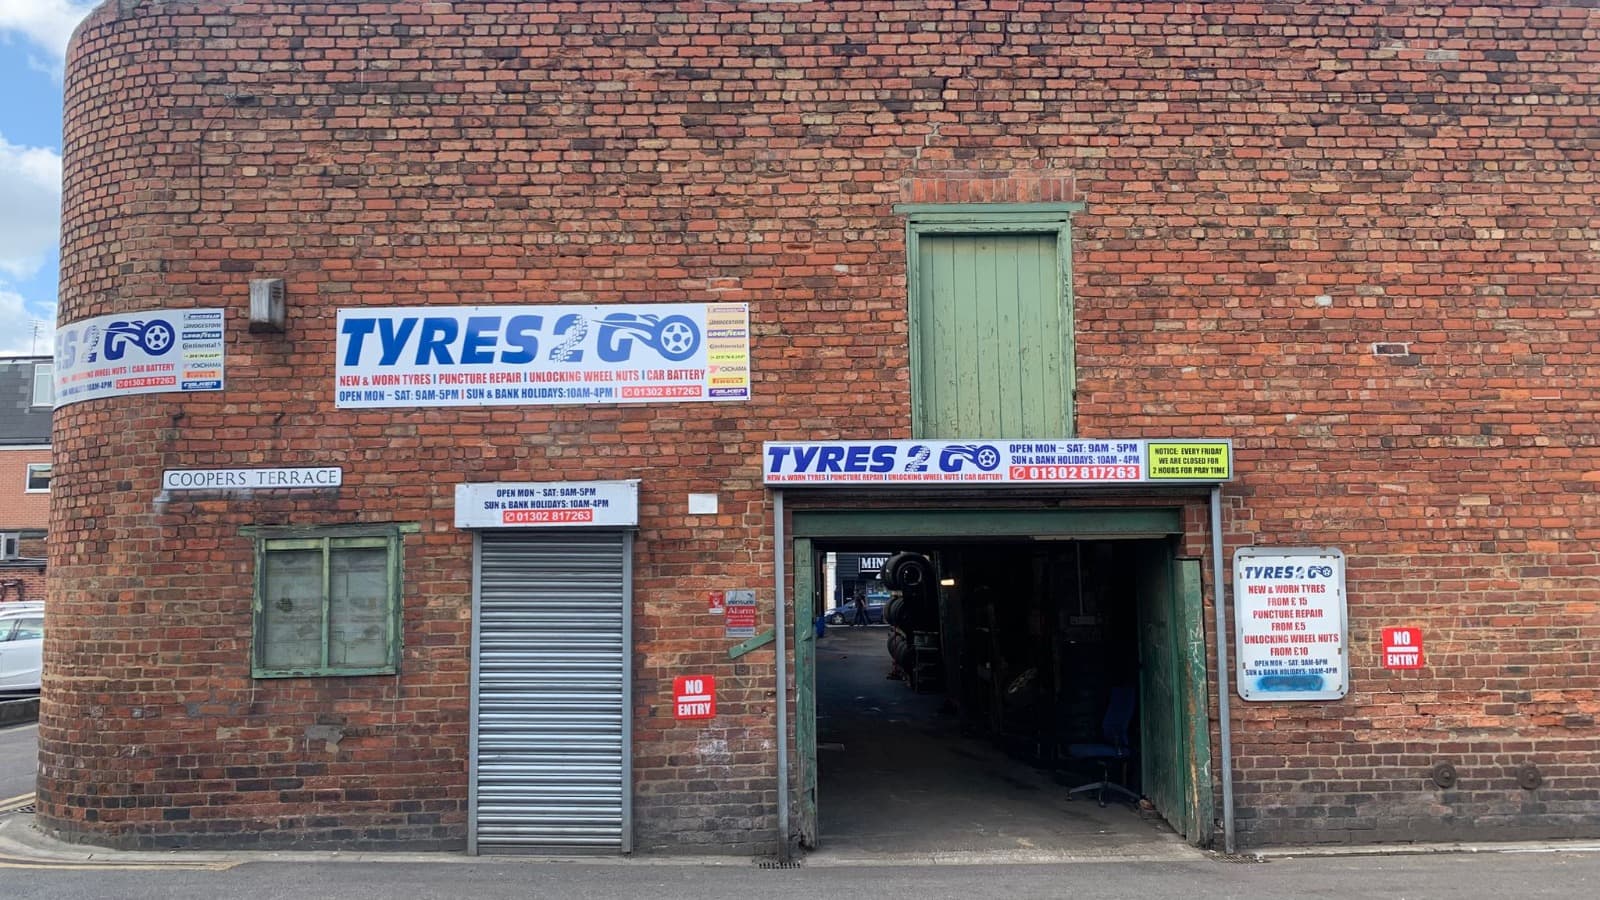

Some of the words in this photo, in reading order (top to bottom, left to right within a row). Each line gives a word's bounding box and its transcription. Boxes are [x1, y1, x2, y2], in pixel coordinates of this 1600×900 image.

[342, 315, 543, 366] TYRES
[549, 314, 588, 363] 2
[132, 364, 145, 373] CAR
[146, 364, 174, 372] BATTERY
[340, 376, 360, 386] NEW
[362, 376, 369, 386] &
[372, 375, 400, 386] WORN
[403, 374, 430, 385] TYRES
[438, 373, 487, 384] PUNCTURE
[490, 372, 522, 384] REPAIR
[530, 370, 581, 382] UNLOCKING
[584, 370, 613, 382] WHEEL
[616, 370, 639, 381] NUTS
[647, 370, 664, 380] CAR
[668, 369, 705, 380] BATTERY
[340, 390, 362, 401] OPEN
[364, 390, 384, 400] MON
[394, 390, 413, 400] SAT:
[416, 389, 459, 400] 9AM-5PM
[466, 388, 484, 399] SUN
[487, 390, 492, 398] &
[495, 388, 519, 398] BANK
[634, 386, 662, 396] 01302
[666, 386, 700, 396] 817263
[1010, 444, 1032, 453] OPEN
[1035, 444, 1056, 452] MON
[1066, 444, 1086, 452] SAT:
[1088, 444, 1108, 452] 9AM
[1116, 444, 1137, 452] 5PM
[768, 446, 897, 472] TYRES
[904, 445, 930, 472] 2
[1012, 456, 1026, 464] SUN
[1036, 456, 1056, 464] BANK
[1058, 456, 1096, 464] HOLIDAYS:
[1097, 455, 1117, 464] 10AM
[1123, 456, 1140, 464] 4PM
[168, 472, 246, 486] COOPERS
[256, 470, 337, 485] TERRACE
[1030, 467, 1077, 480] 01302
[1080, 467, 1136, 479] 817263
[496, 489, 516, 497] OPEN
[518, 488, 534, 497] MON
[542, 488, 558, 497] SAT:
[560, 488, 596, 496] 9AM-5PM
[484, 501, 499, 509] SUN
[508, 500, 529, 509] BANK
[530, 500, 568, 508] HOLIDAYS:
[570, 499, 609, 508] 10AM-4PM
[516, 512, 549, 521] 01302
[552, 511, 590, 520] 817263
[862, 557, 888, 568] MIN
[1245, 566, 1294, 579] TYRES
[1296, 566, 1304, 579] 2
[1248, 585, 1266, 594] NEW
[1268, 586, 1273, 594] &
[1275, 585, 1299, 594] WORN
[1302, 584, 1326, 593] TYRES
[1268, 598, 1290, 606] FROM
[1299, 597, 1307, 606] 15
[1253, 610, 1294, 619] PUNCTURE
[1295, 609, 1323, 618] REPAIR
[1272, 622, 1293, 631] FROM
[1295, 622, 1306, 630] £5
[1244, 634, 1288, 644] UNLOCKING
[1290, 634, 1316, 643] WHEEL
[1318, 634, 1339, 643] NUTS
[1393, 631, 1410, 645] NO
[1270, 648, 1292, 656] FROM
[1294, 647, 1308, 656] £10
[1388, 654, 1418, 666] ENTRY
[685, 680, 703, 694] NO
[678, 703, 711, 716] ENTRY
